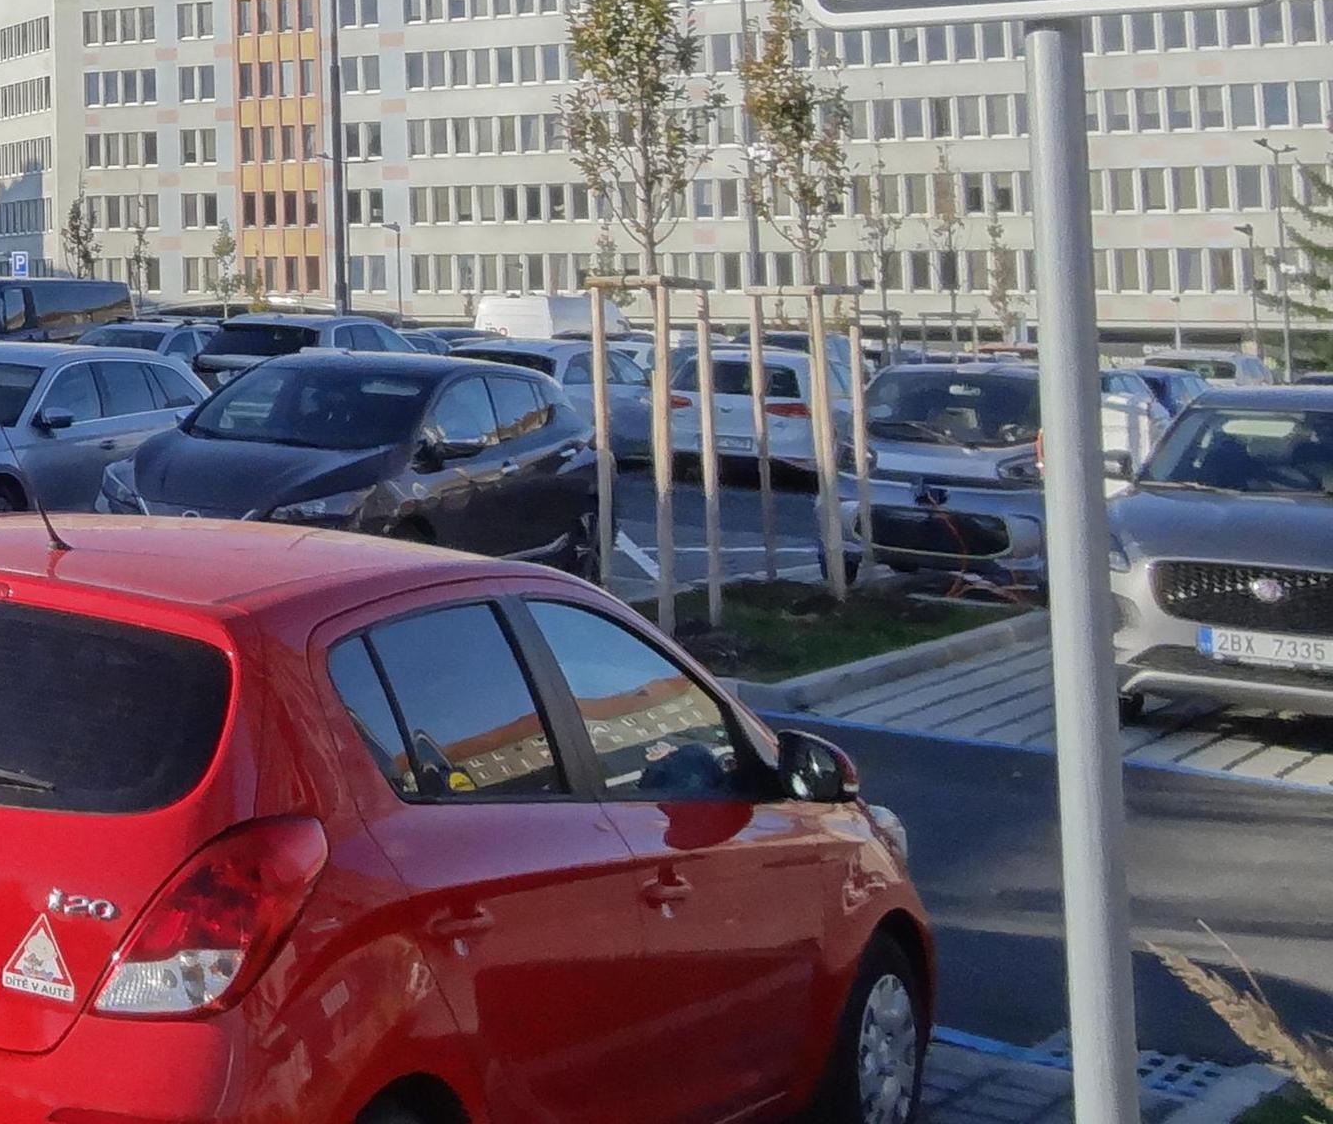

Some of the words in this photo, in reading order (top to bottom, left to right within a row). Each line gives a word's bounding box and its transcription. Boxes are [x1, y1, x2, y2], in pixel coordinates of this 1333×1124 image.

[16, 255, 26, 270] P
[1217, 630, 1256, 653] 2BX
[1272, 639, 1326, 660] 7335
[48, 886, 116, 920] i20
[31, 981, 39, 991] V
